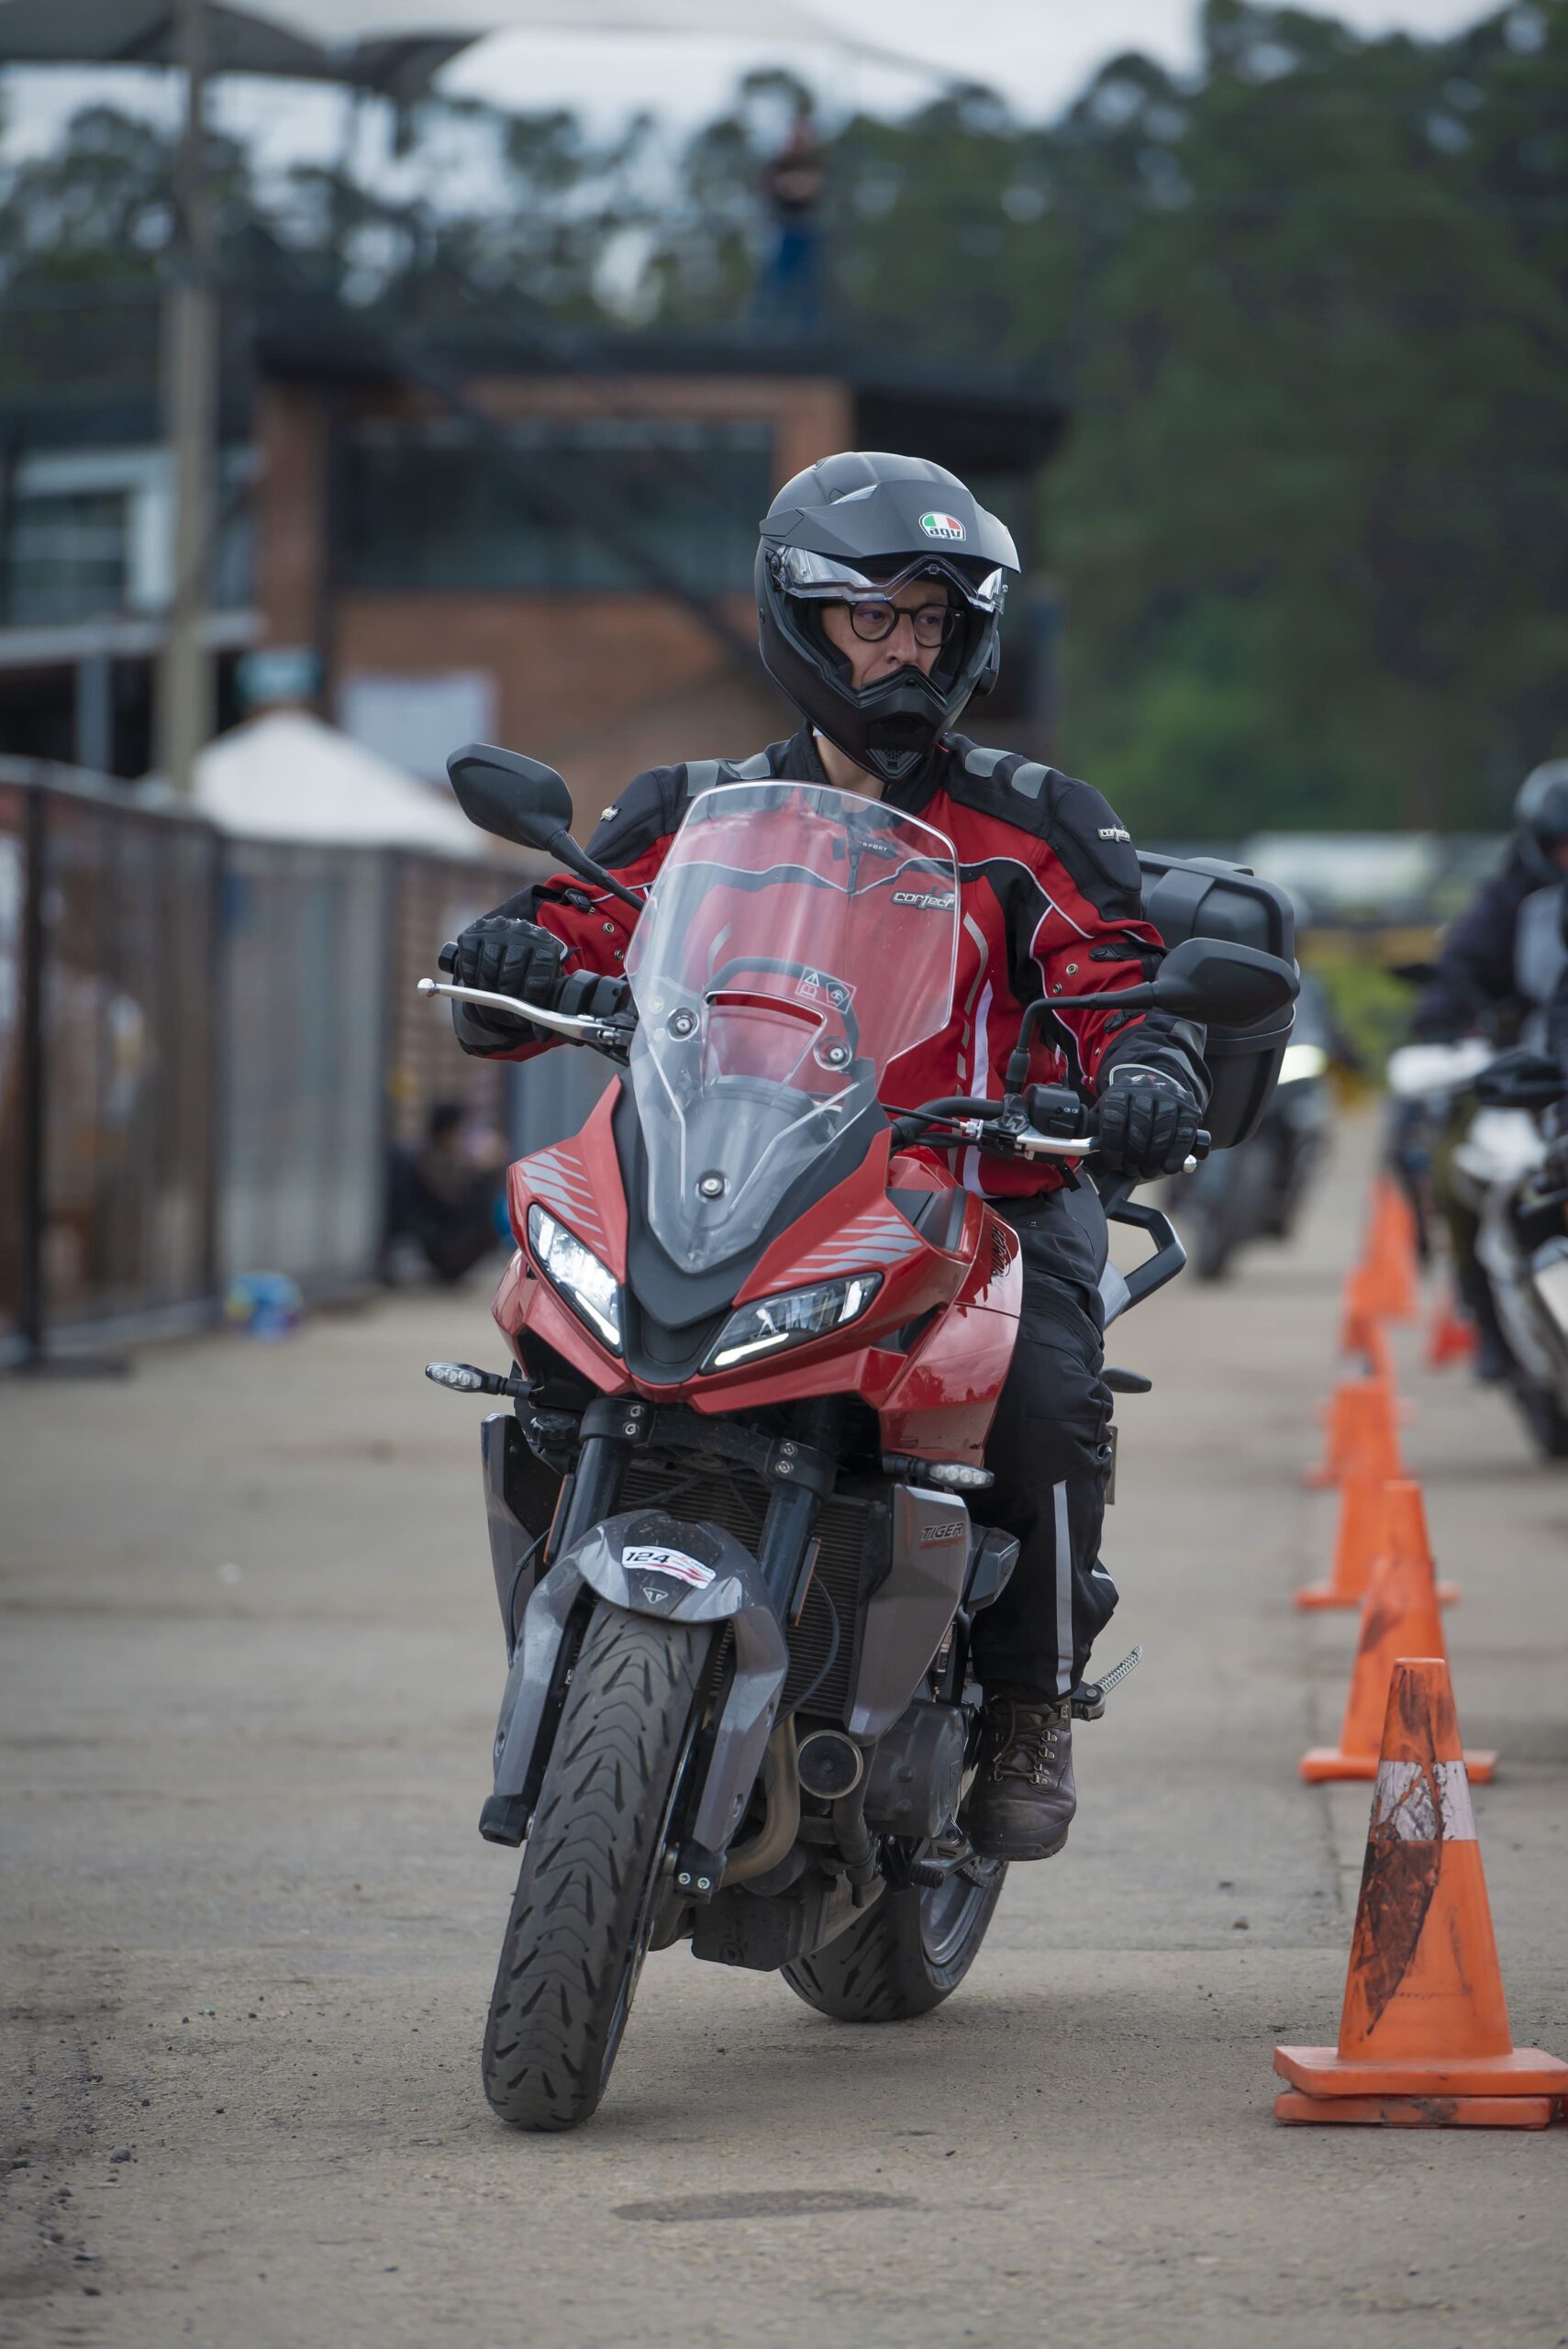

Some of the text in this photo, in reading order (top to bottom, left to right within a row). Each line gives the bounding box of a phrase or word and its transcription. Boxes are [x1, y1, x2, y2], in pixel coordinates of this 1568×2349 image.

[929, 527, 961, 539] agv
[922, 1523, 964, 1540] TIGER
[626, 1552, 670, 1564] 124
